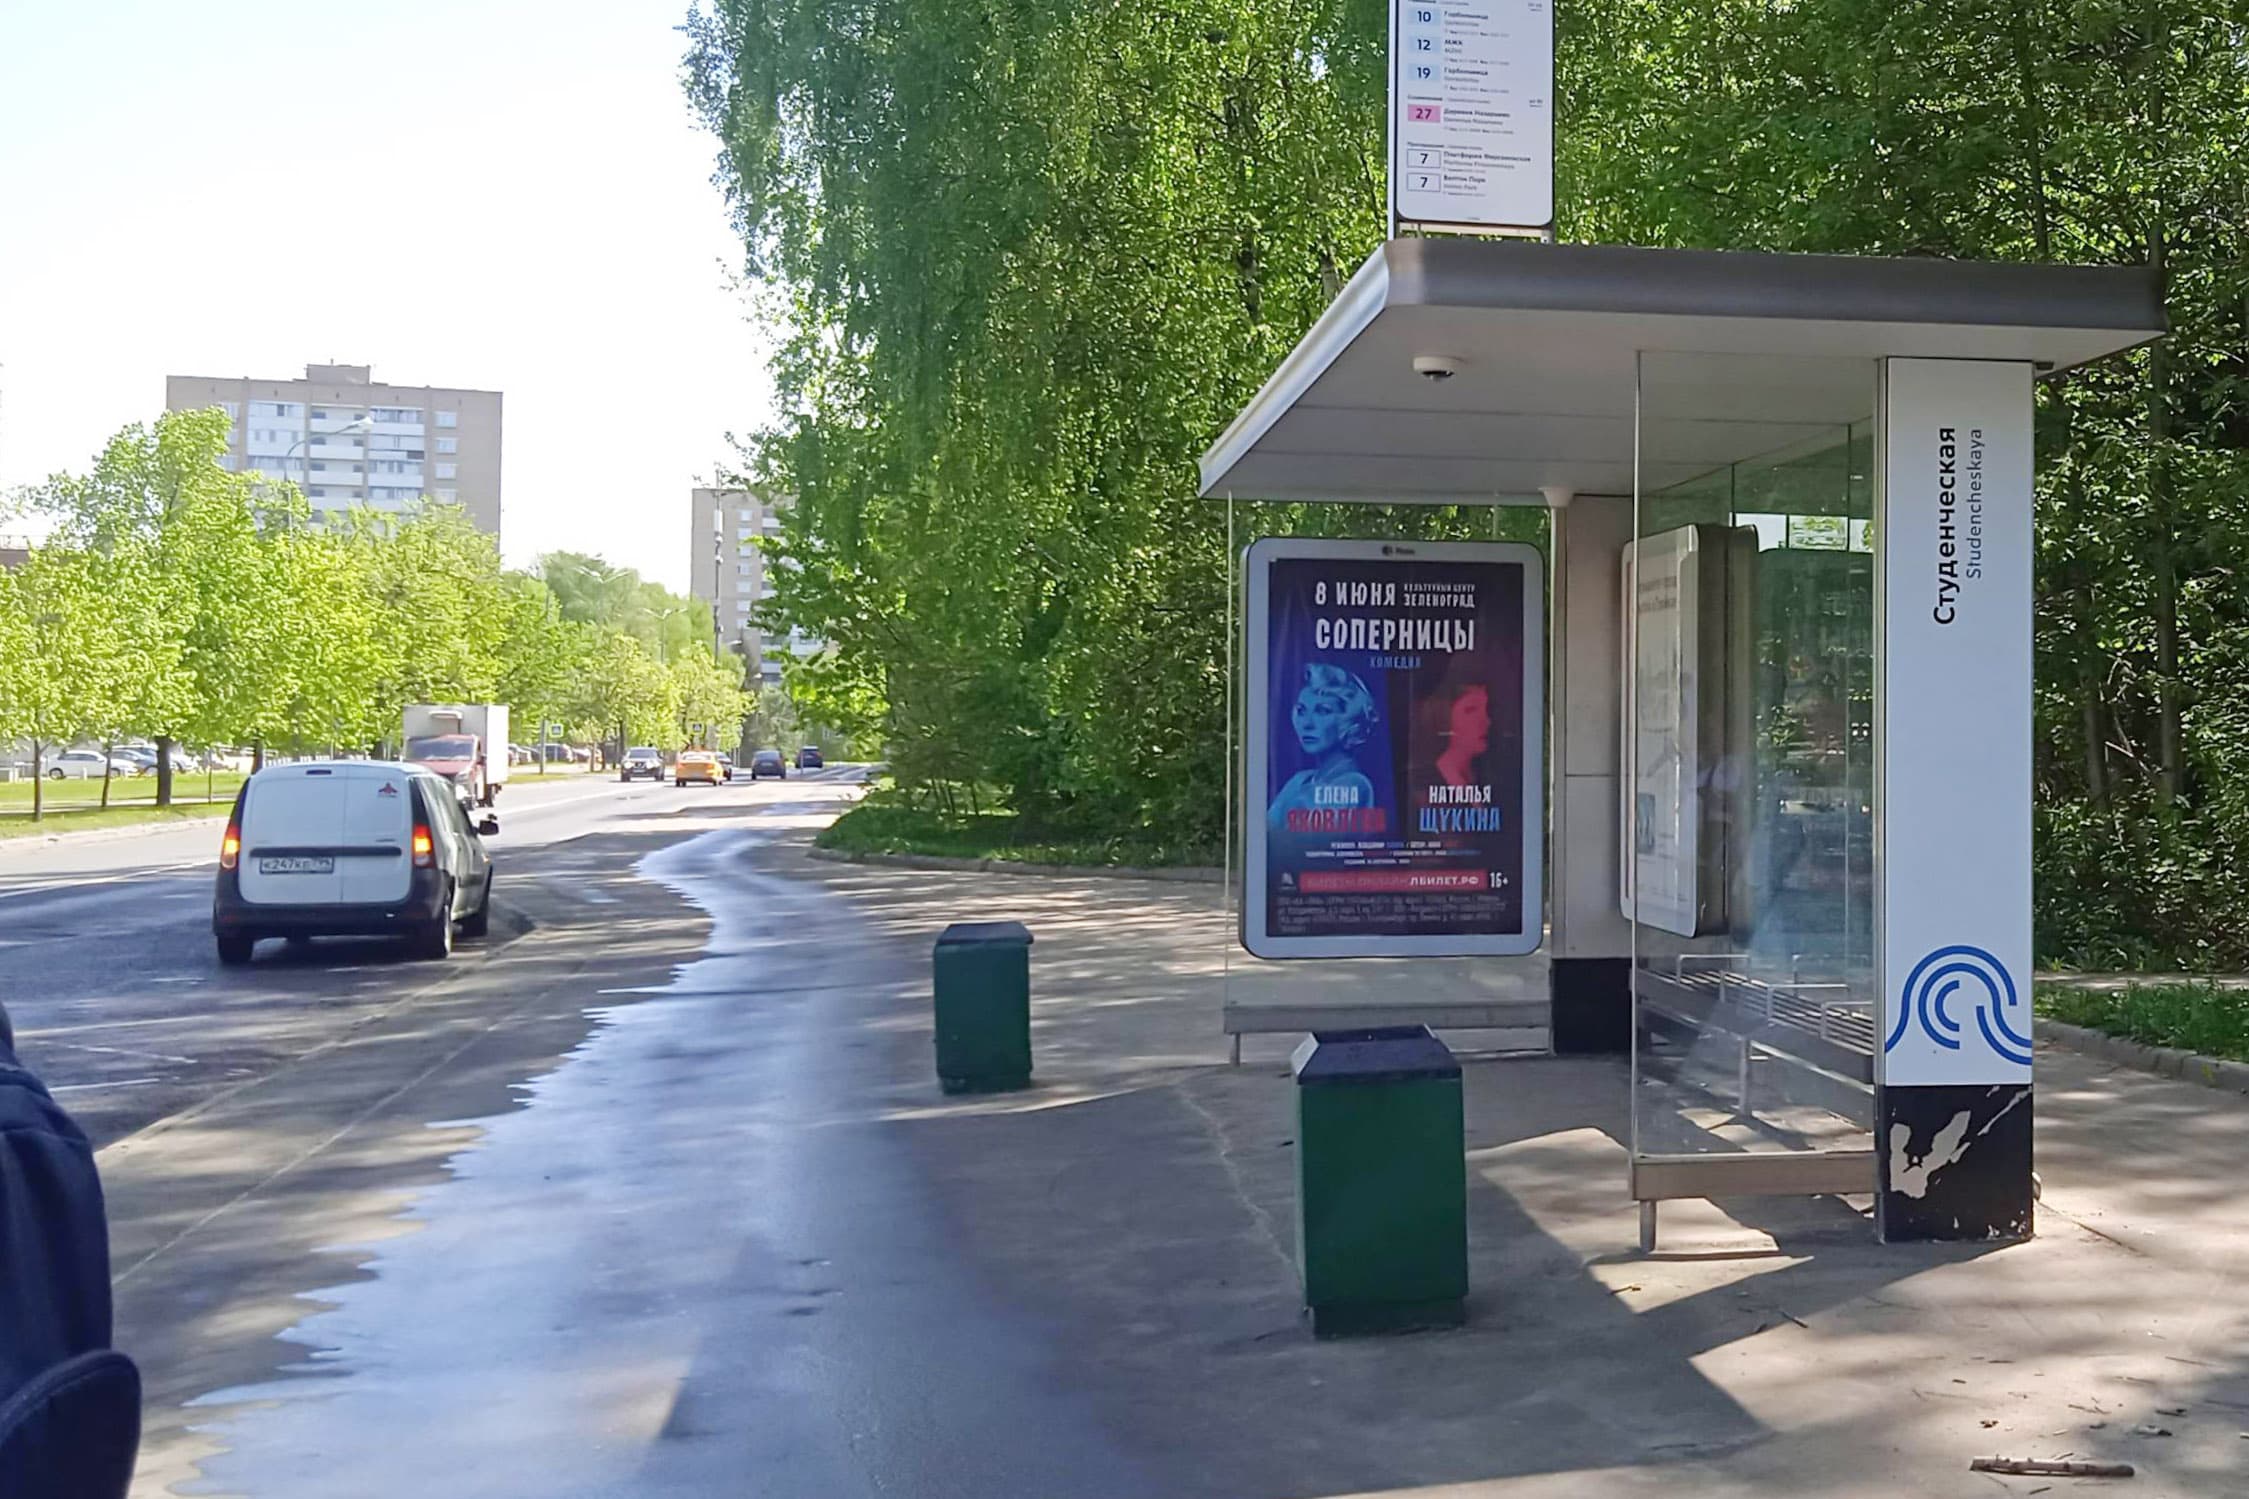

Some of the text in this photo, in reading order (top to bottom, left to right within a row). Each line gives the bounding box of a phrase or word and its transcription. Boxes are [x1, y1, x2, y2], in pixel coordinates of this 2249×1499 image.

[1417, 11, 1431, 22] 10
[1417, 39, 1431, 50] 12
[1417, 67, 1431, 79] 19
[1415, 108, 1432, 119] 27
[1420, 153, 1428, 164] 7
[1420, 177, 1428, 188] 7
[1966, 429, 1985, 579] Studencheskaya
[1933, 428, 1960, 624] Студенческая
[1315, 581, 1395, 606] 8 ИЮНЯ
[1403, 593, 1476, 608] ЗЕЛЕНОГРАД
[1315, 618, 1475, 653] СОПЕРНИЦЫ
[1314, 786, 1359, 804] ЕЛЕНА
[1429, 785, 1491, 804] НАТАЛЬЯ
[1420, 807, 1500, 833] ЩУКИНА
[1490, 872, 1508, 888] 16+
